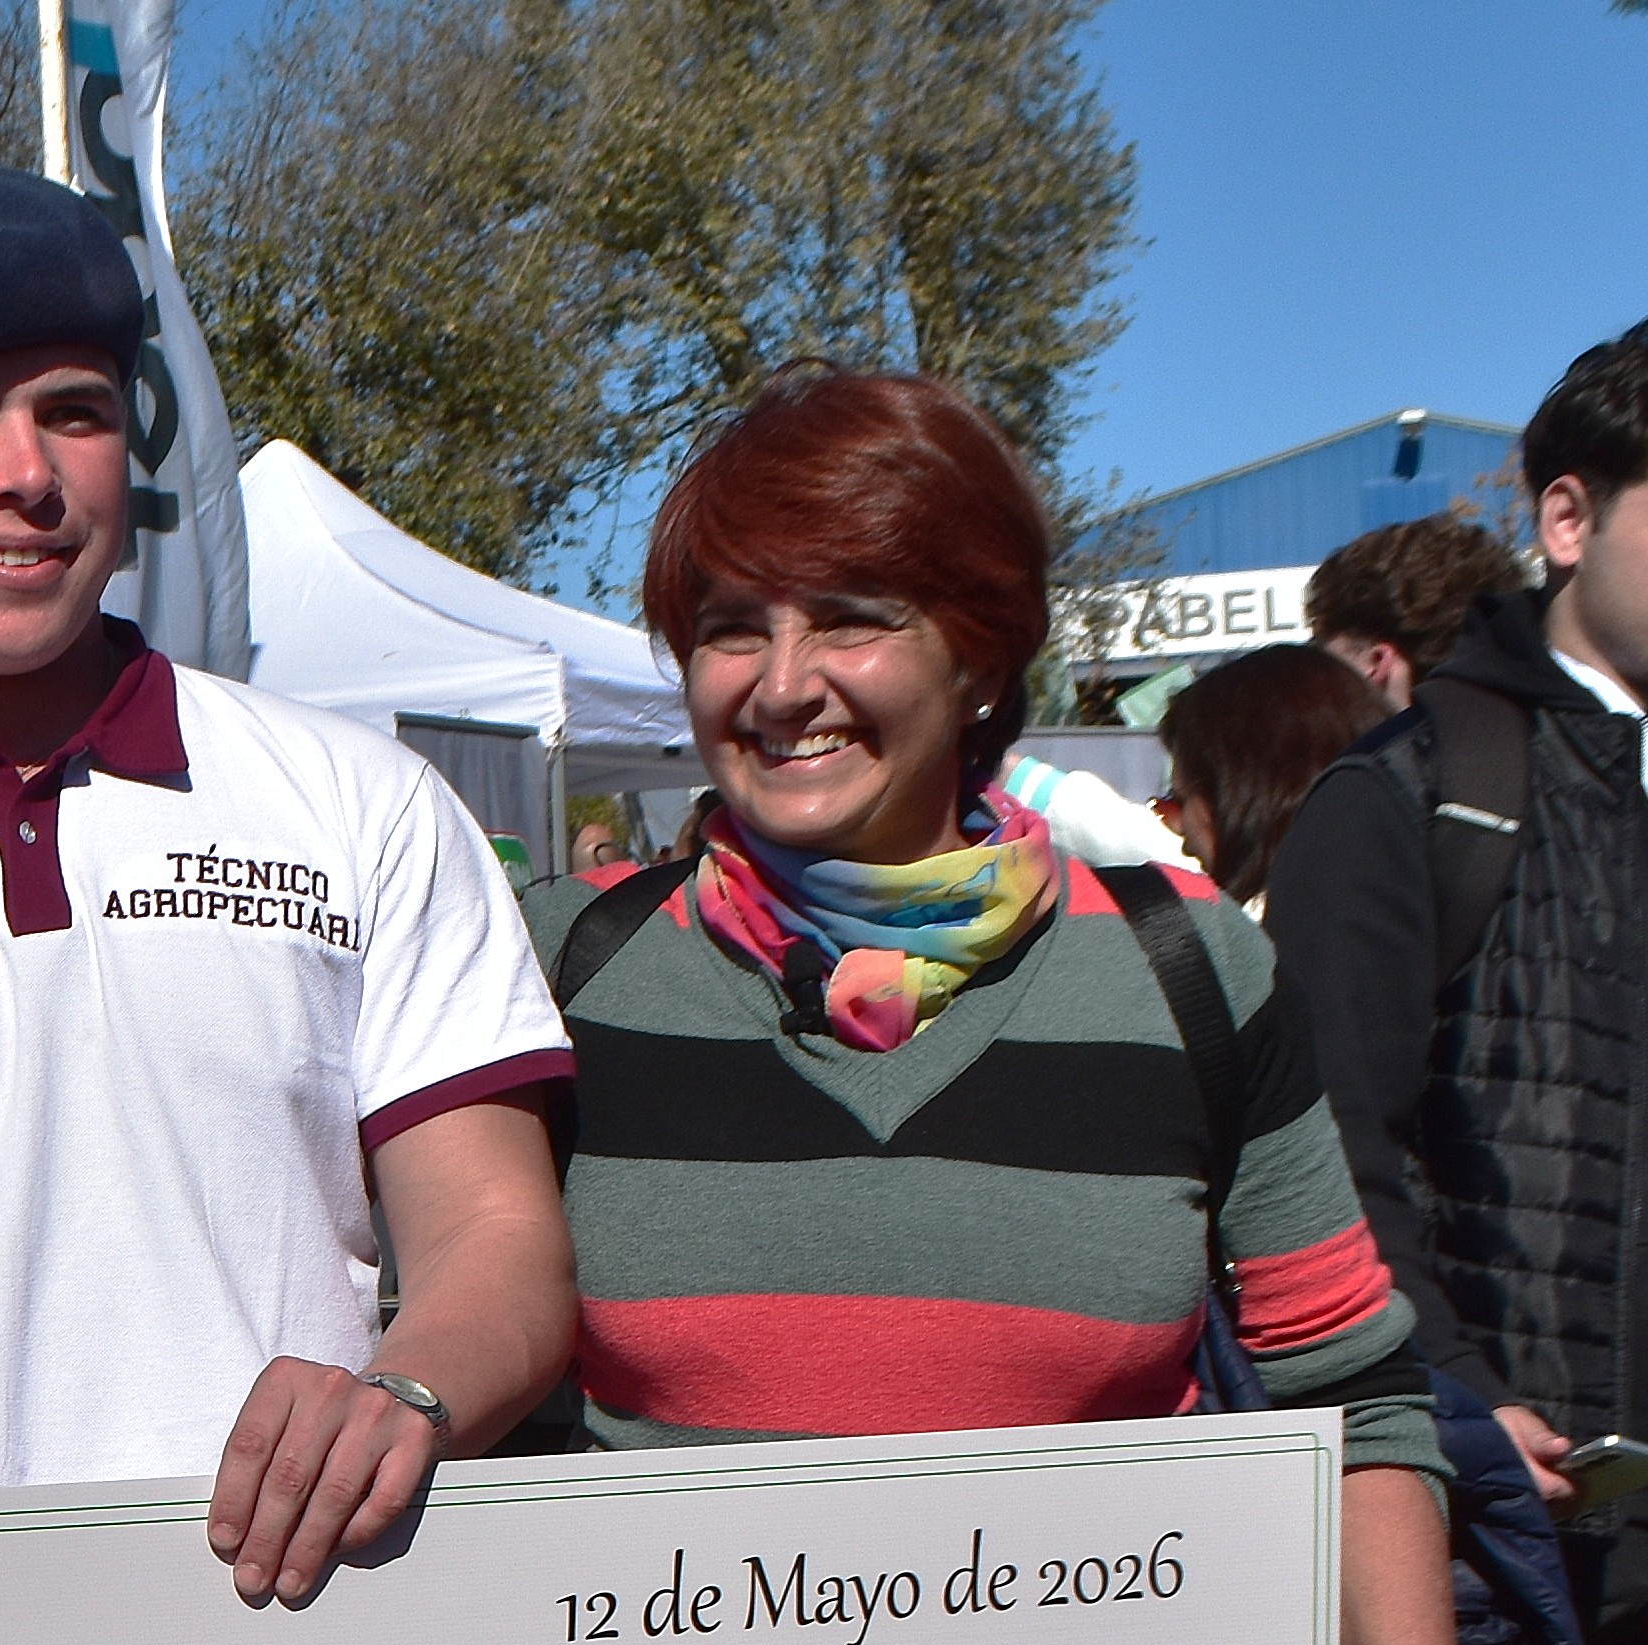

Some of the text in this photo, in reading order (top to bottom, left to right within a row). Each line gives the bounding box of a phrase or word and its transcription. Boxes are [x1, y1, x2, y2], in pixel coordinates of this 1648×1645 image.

[1085, 586, 1313, 648] PABEL
[167, 843, 329, 904] TÉCNICO
[555, 1591, 620, 1643] 12
[641, 1548, 723, 1637] de
[942, 1528, 1019, 1615] de
[1037, 1530, 1185, 1606] 2026
